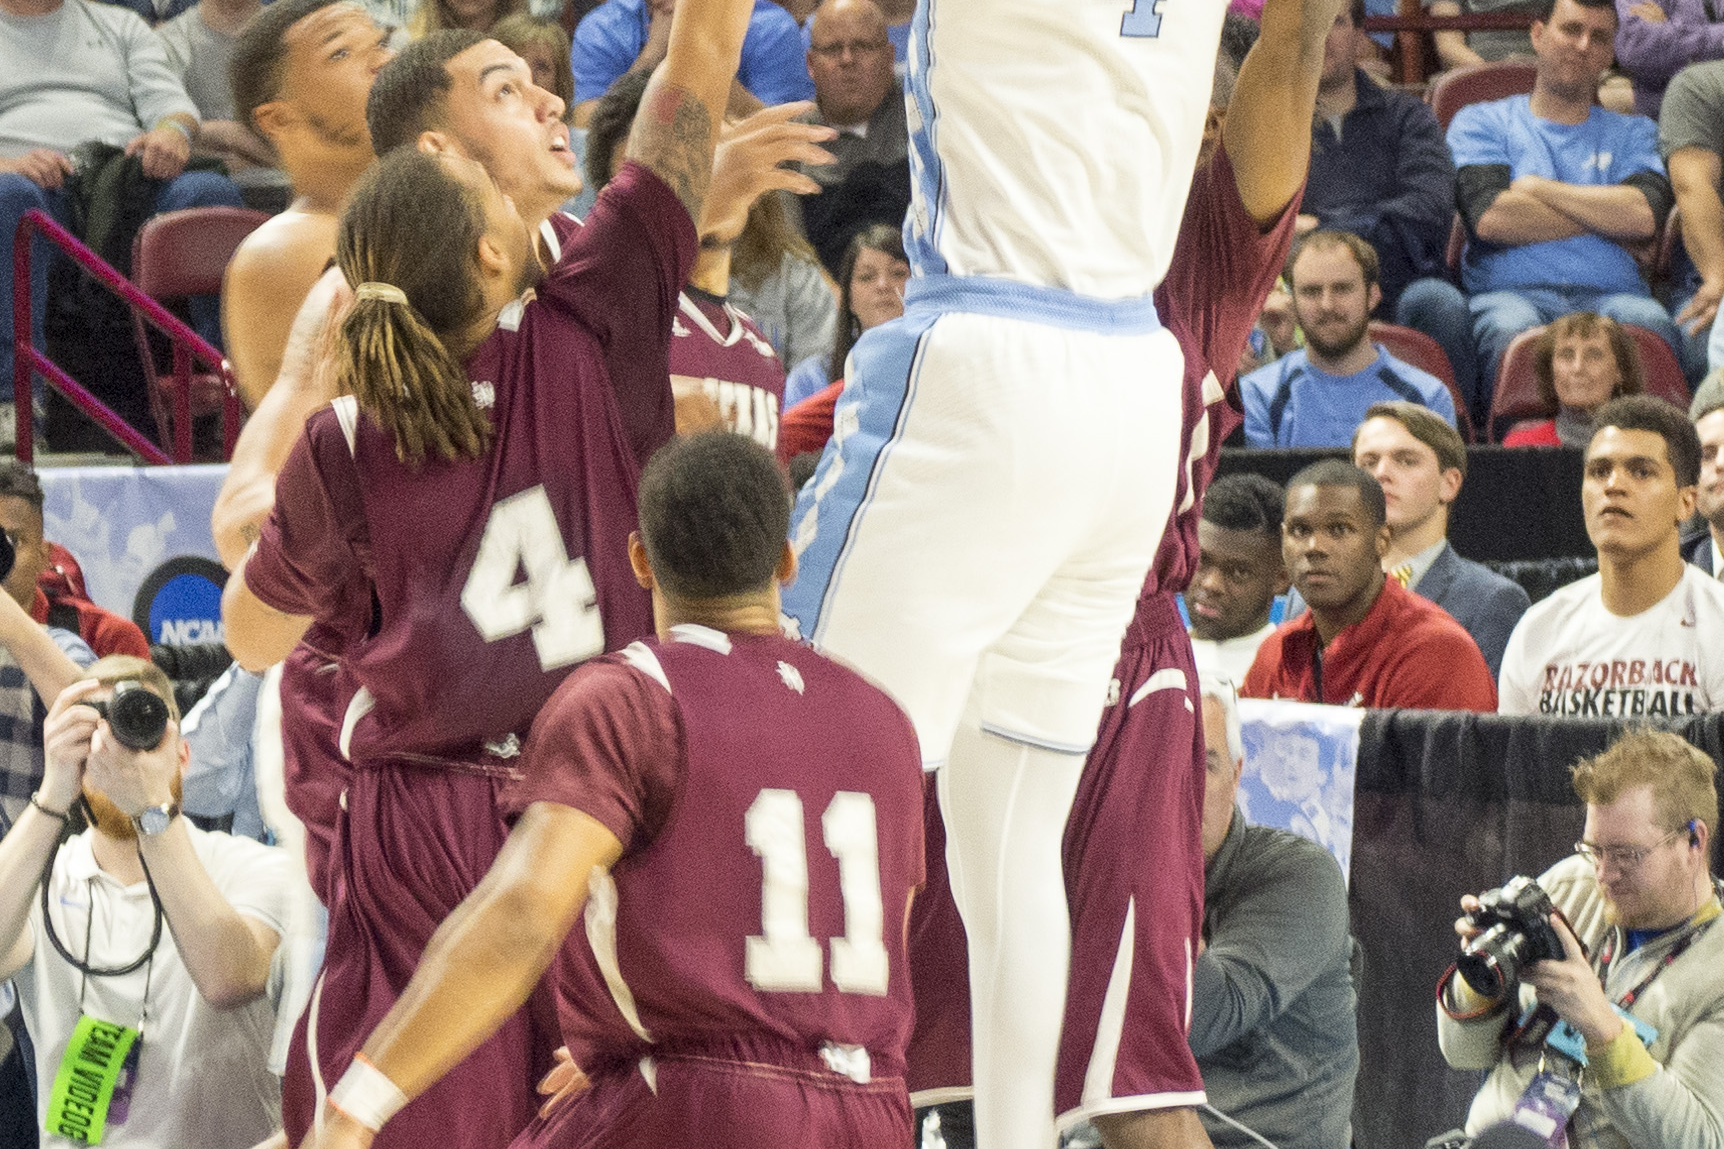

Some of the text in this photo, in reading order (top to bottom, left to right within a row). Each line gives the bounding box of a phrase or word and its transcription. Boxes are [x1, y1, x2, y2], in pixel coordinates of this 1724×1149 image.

[460, 483, 605, 674] 4
[1539, 689, 1694, 717] BASKETBALL
[1544, 659, 1698, 691] RAZORBACK
[744, 788, 889, 998] 11
